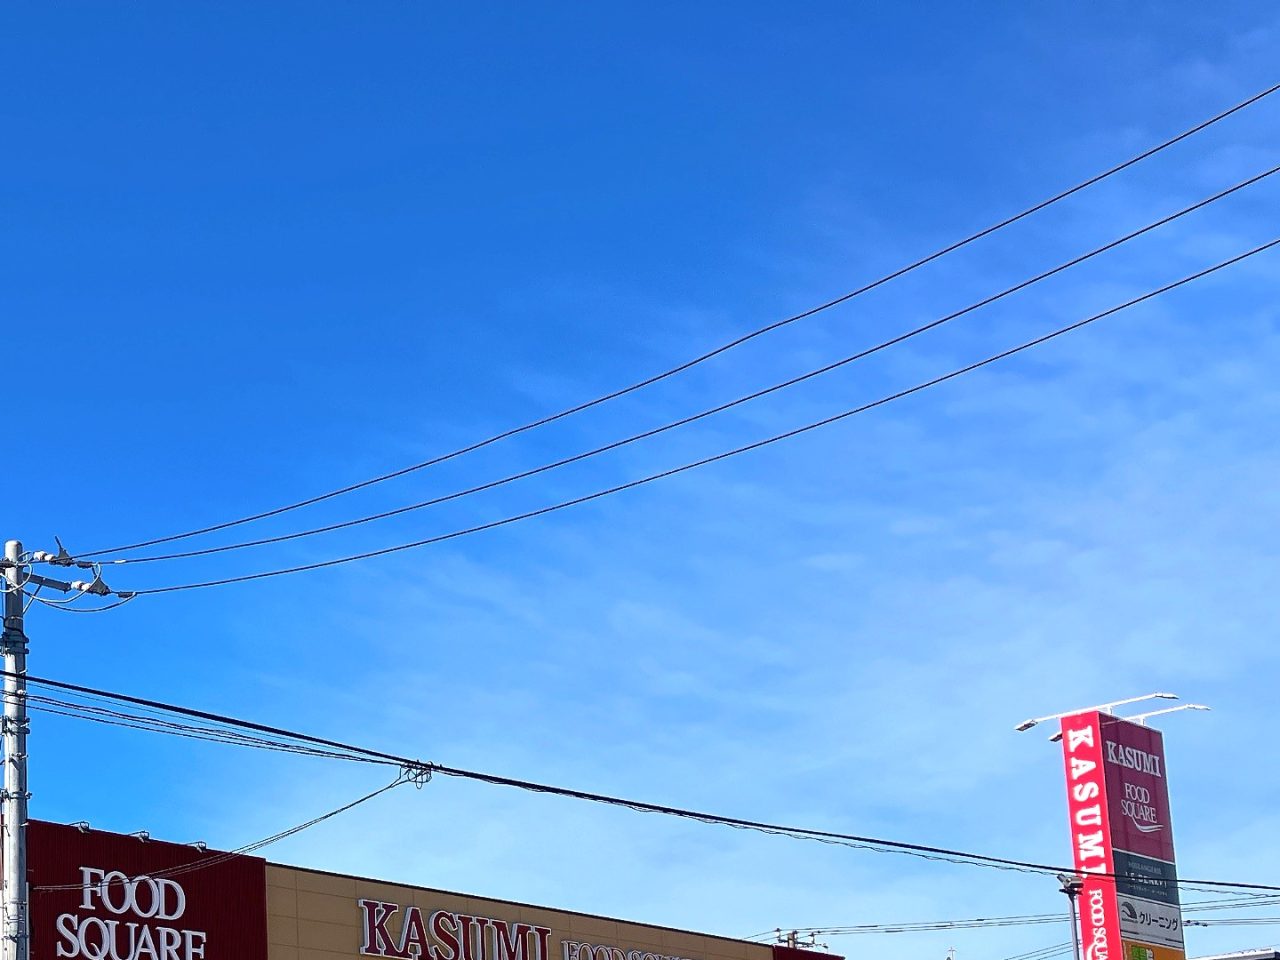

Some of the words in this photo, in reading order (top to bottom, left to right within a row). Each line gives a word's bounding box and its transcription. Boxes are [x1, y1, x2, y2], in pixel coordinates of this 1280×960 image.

[1106, 740, 1161, 777] KASUMI
[1067, 725, 1107, 879] KASUMI
[1124, 783, 1150, 804] FOOD
[1121, 799, 1163, 832] SQUARE
[79, 866, 186, 920] FOOD
[1139, 912, 1178, 931] クリーニング
